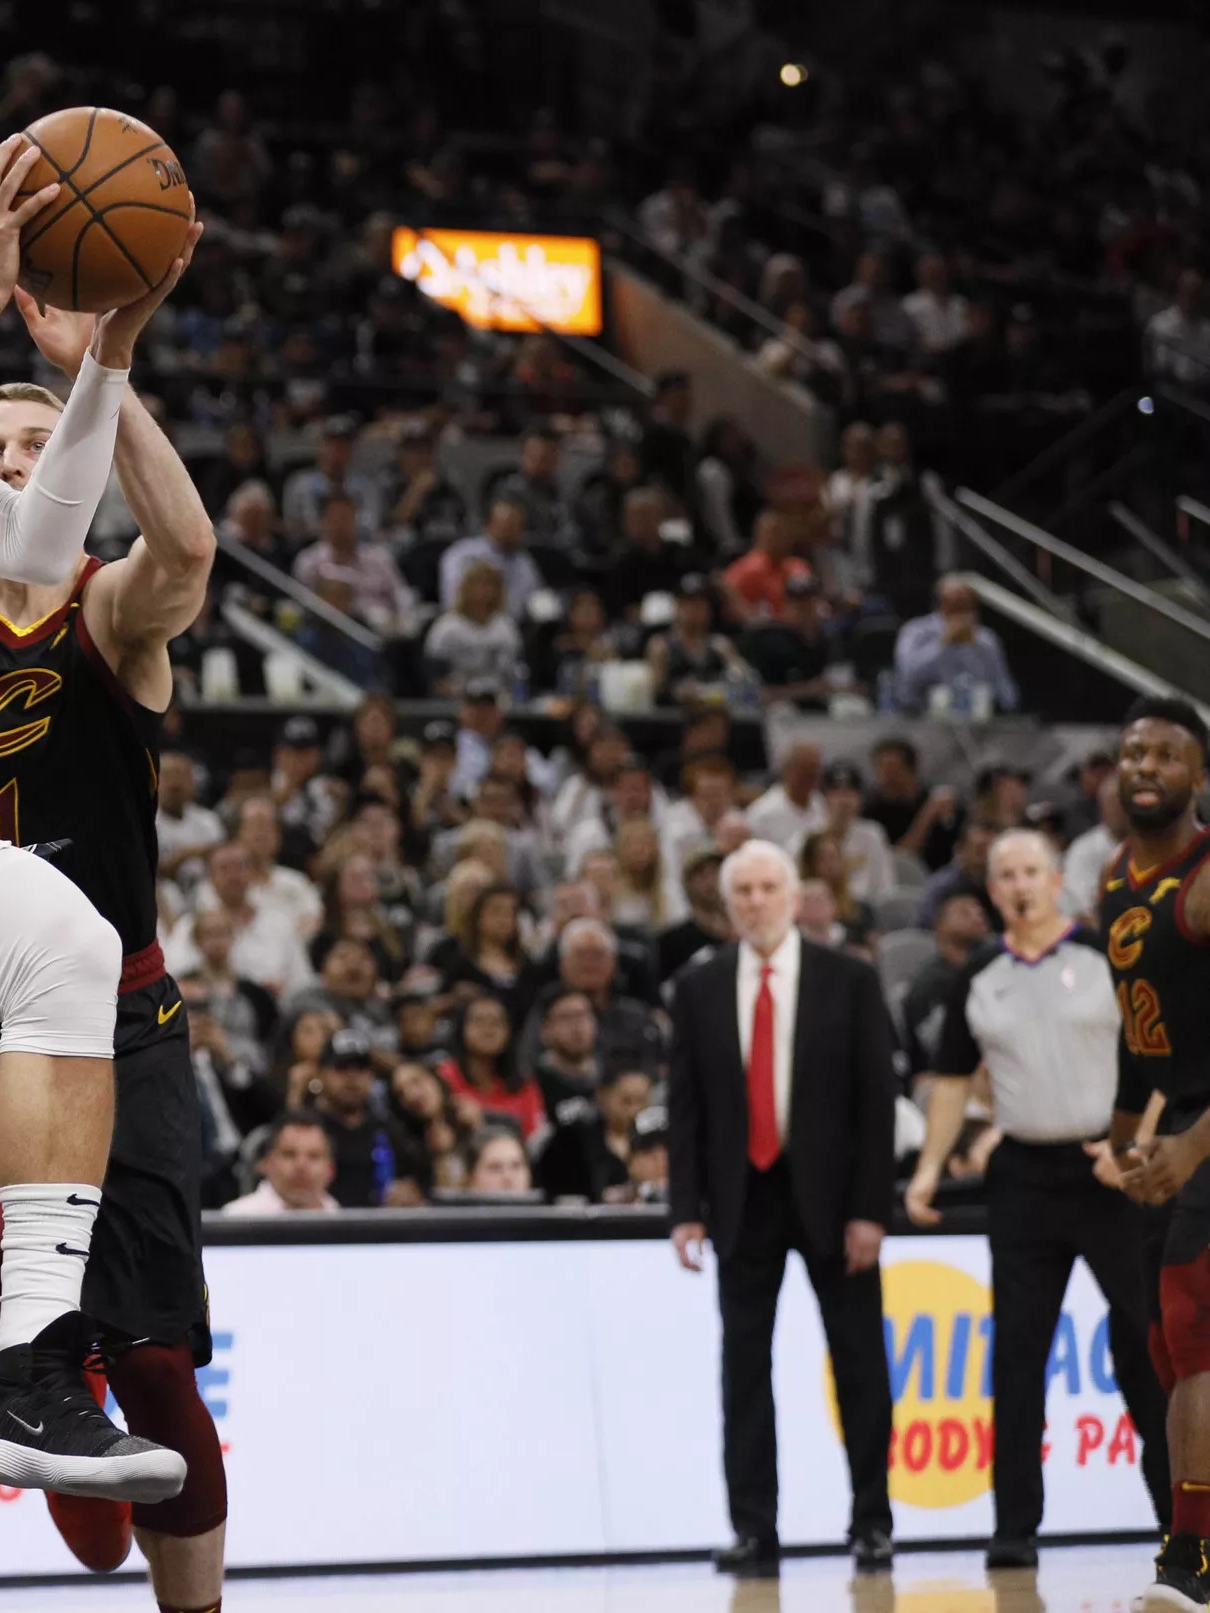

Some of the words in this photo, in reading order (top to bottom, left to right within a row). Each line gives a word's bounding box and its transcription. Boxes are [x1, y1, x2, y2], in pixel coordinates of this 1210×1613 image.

[1108, 906, 1153, 970] C
[1116, 978, 1172, 1056] 12
[888, 1416, 994, 1472] ODY
